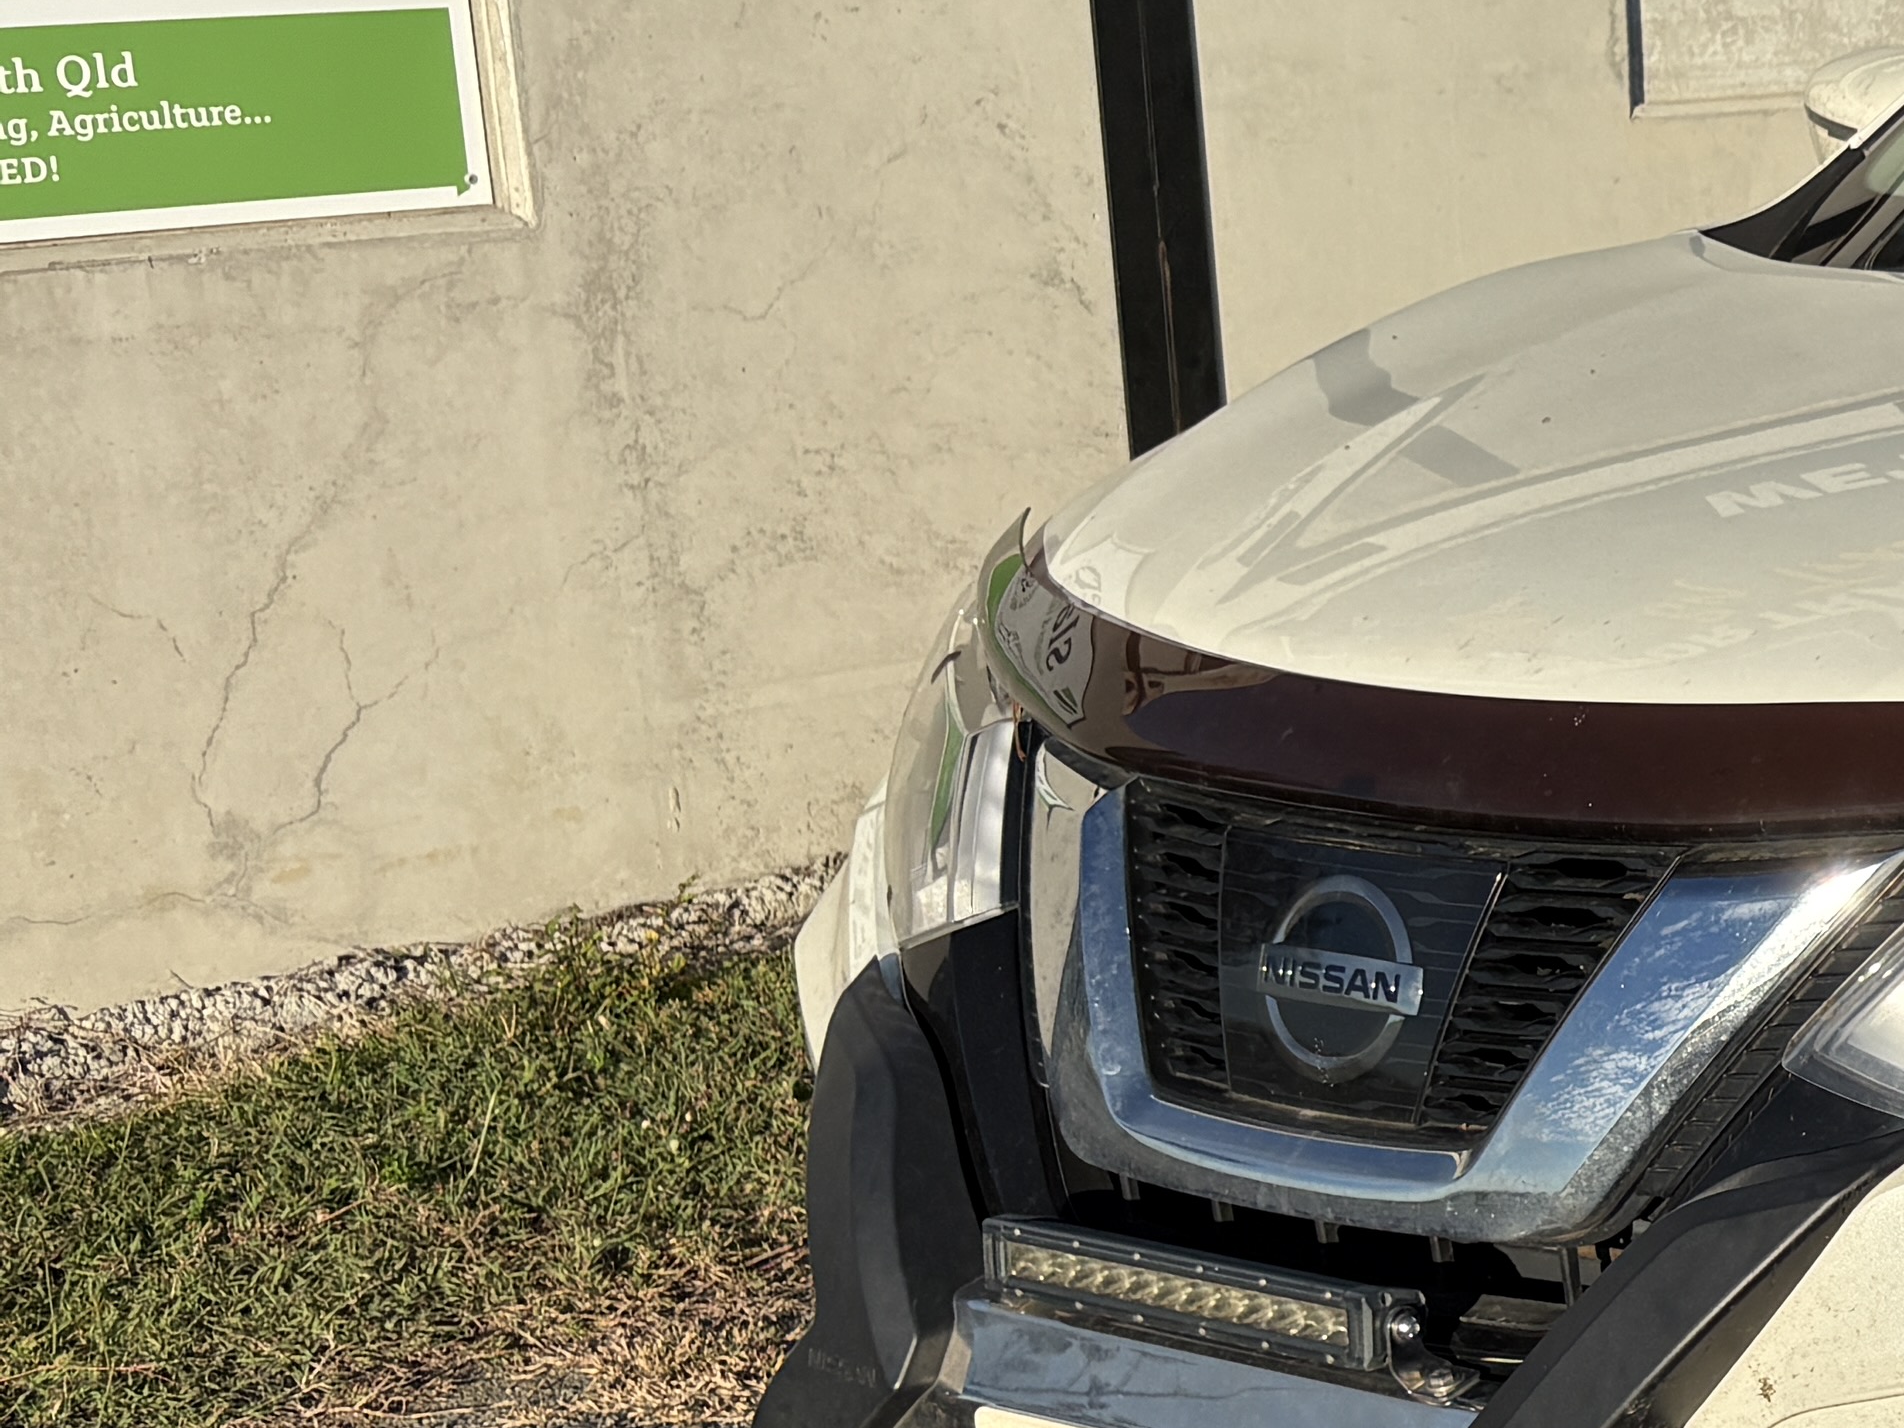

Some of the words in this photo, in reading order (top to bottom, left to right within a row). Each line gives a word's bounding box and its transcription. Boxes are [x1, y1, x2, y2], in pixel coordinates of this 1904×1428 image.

[56, 51, 139, 99] Qld
[47, 100, 273, 142] Agriculture...
[1263, 955, 1402, 1004] NISSAN
